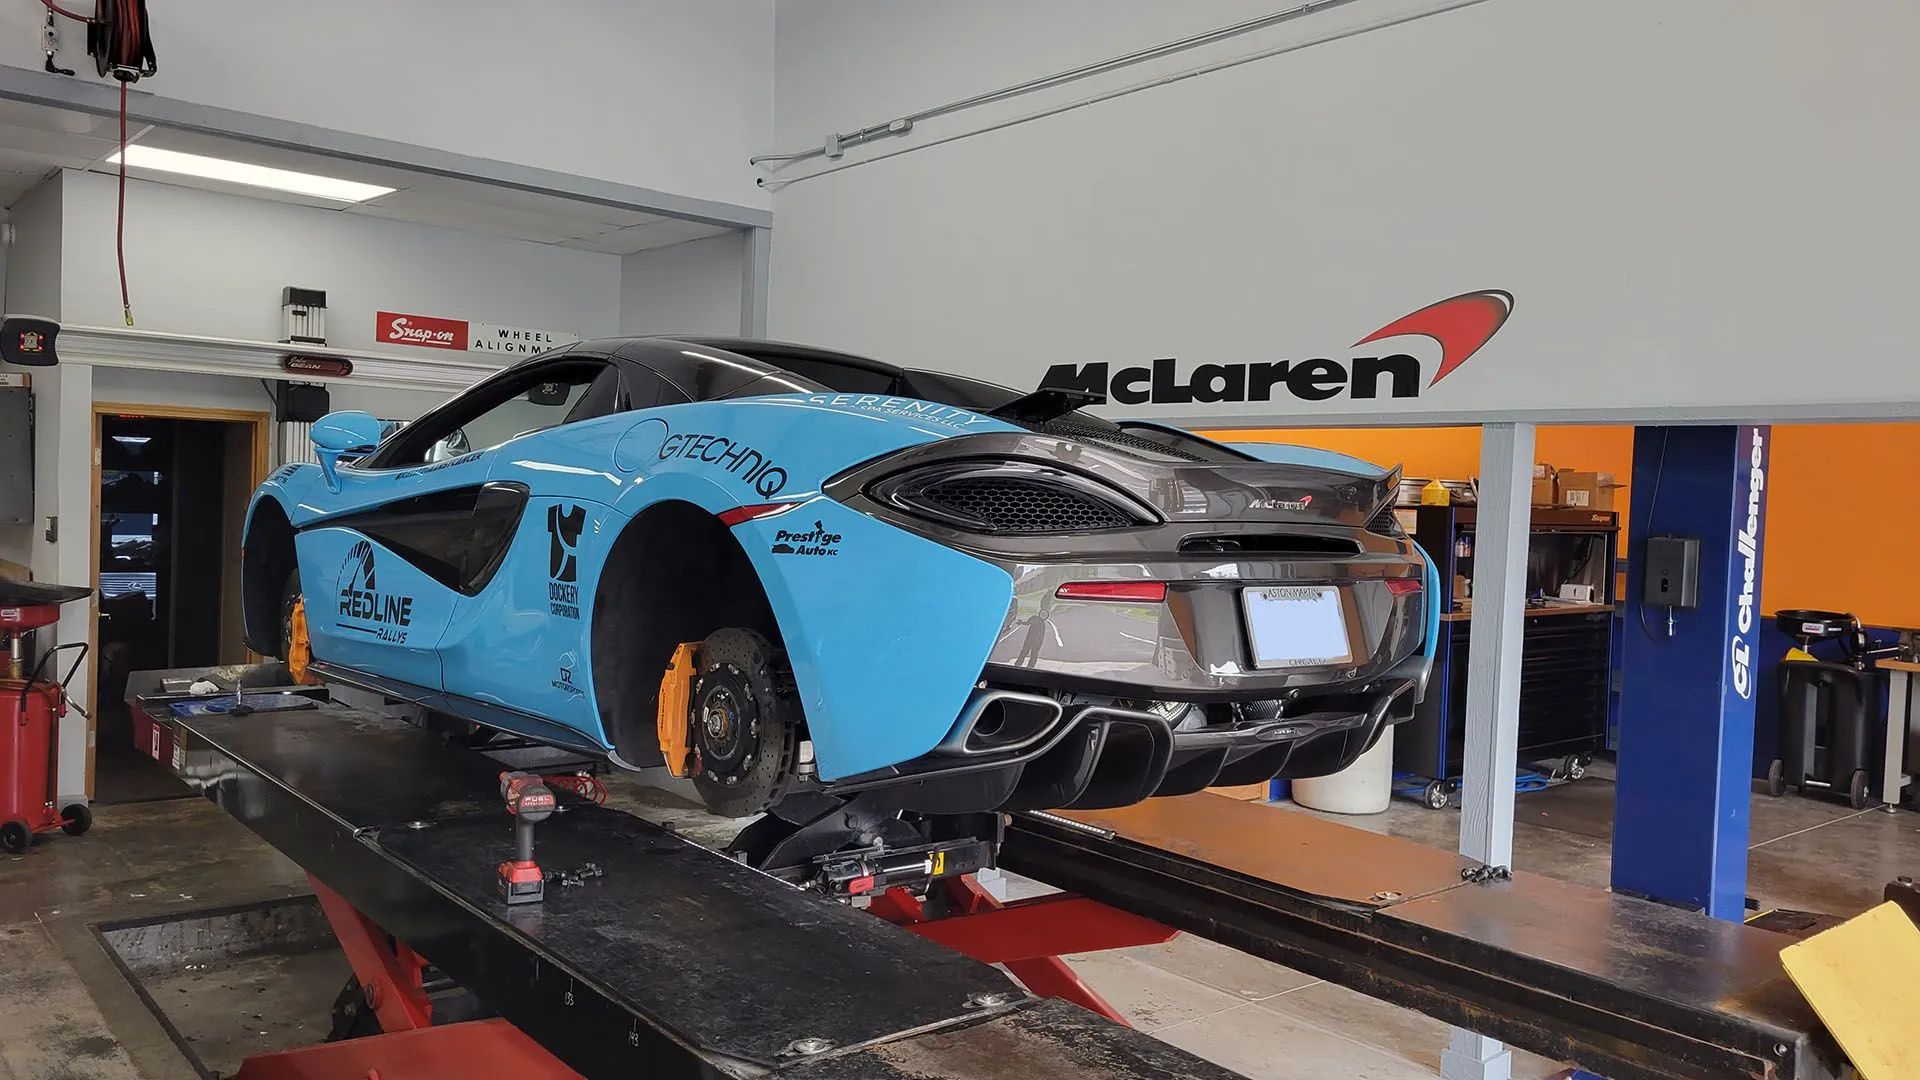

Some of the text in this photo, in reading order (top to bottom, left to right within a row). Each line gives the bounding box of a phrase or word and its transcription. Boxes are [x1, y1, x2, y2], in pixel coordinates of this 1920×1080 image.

[389, 317, 454, 344] Snap-on
[498, 329, 552, 342] WHEEL
[1036, 354, 1421, 405] McLaren
[808, 394, 990, 426] SERENITY
[884, 408, 944, 423] SERVICES
[940, 420, 965, 430] LLC
[658, 433, 788, 500] GTECHNIQ
[775, 523, 842, 546] Prestige
[795, 545, 839, 556] Auto KC
[549, 582, 579, 605] DOCKERY
[1267, 588, 1319, 598] ASTON MARTIN
[340, 589, 413, 627] REDLINE
[550, 602, 580, 620] CORPORATION
[376, 627, 408, 644] RALLYS
